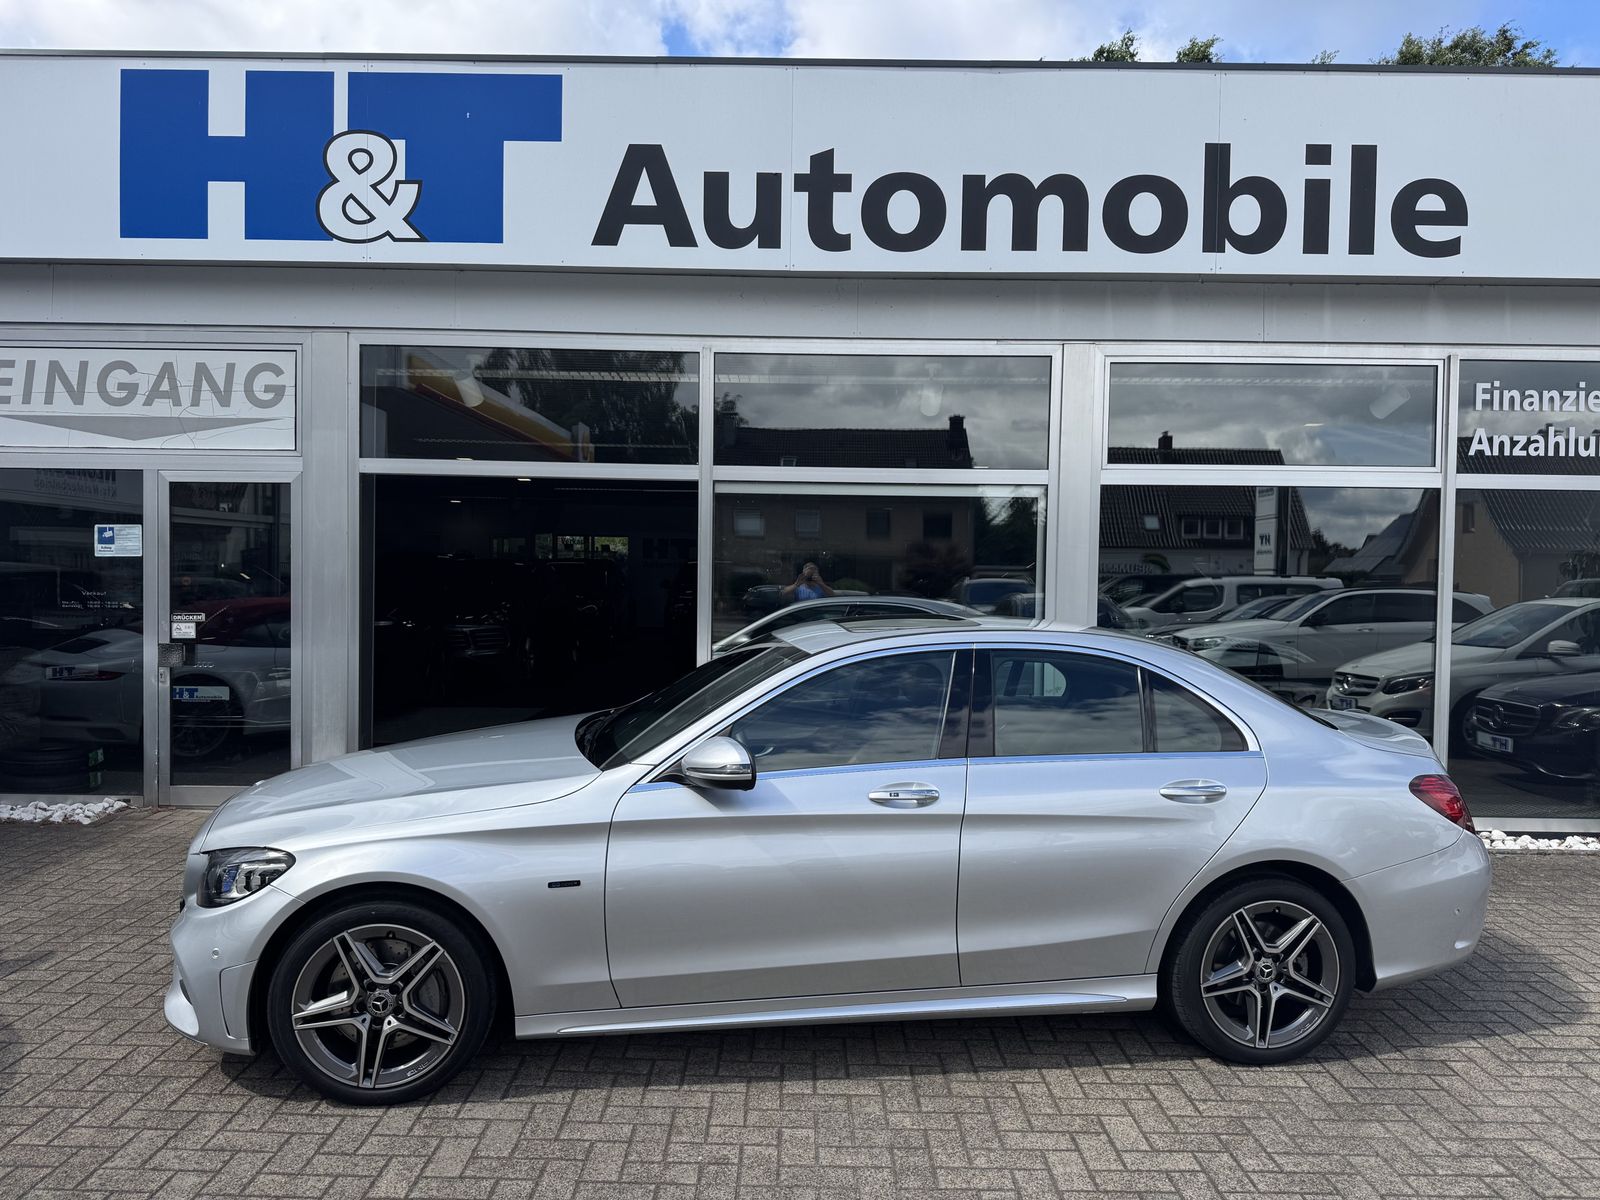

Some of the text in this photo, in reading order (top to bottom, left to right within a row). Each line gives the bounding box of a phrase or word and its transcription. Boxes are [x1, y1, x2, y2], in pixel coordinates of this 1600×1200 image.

[120, 69, 1470, 258] H&T Automobile
[1468, 426, 1600, 457] Anzahlu
[172, 613, 203, 621] DRÜCKEN
